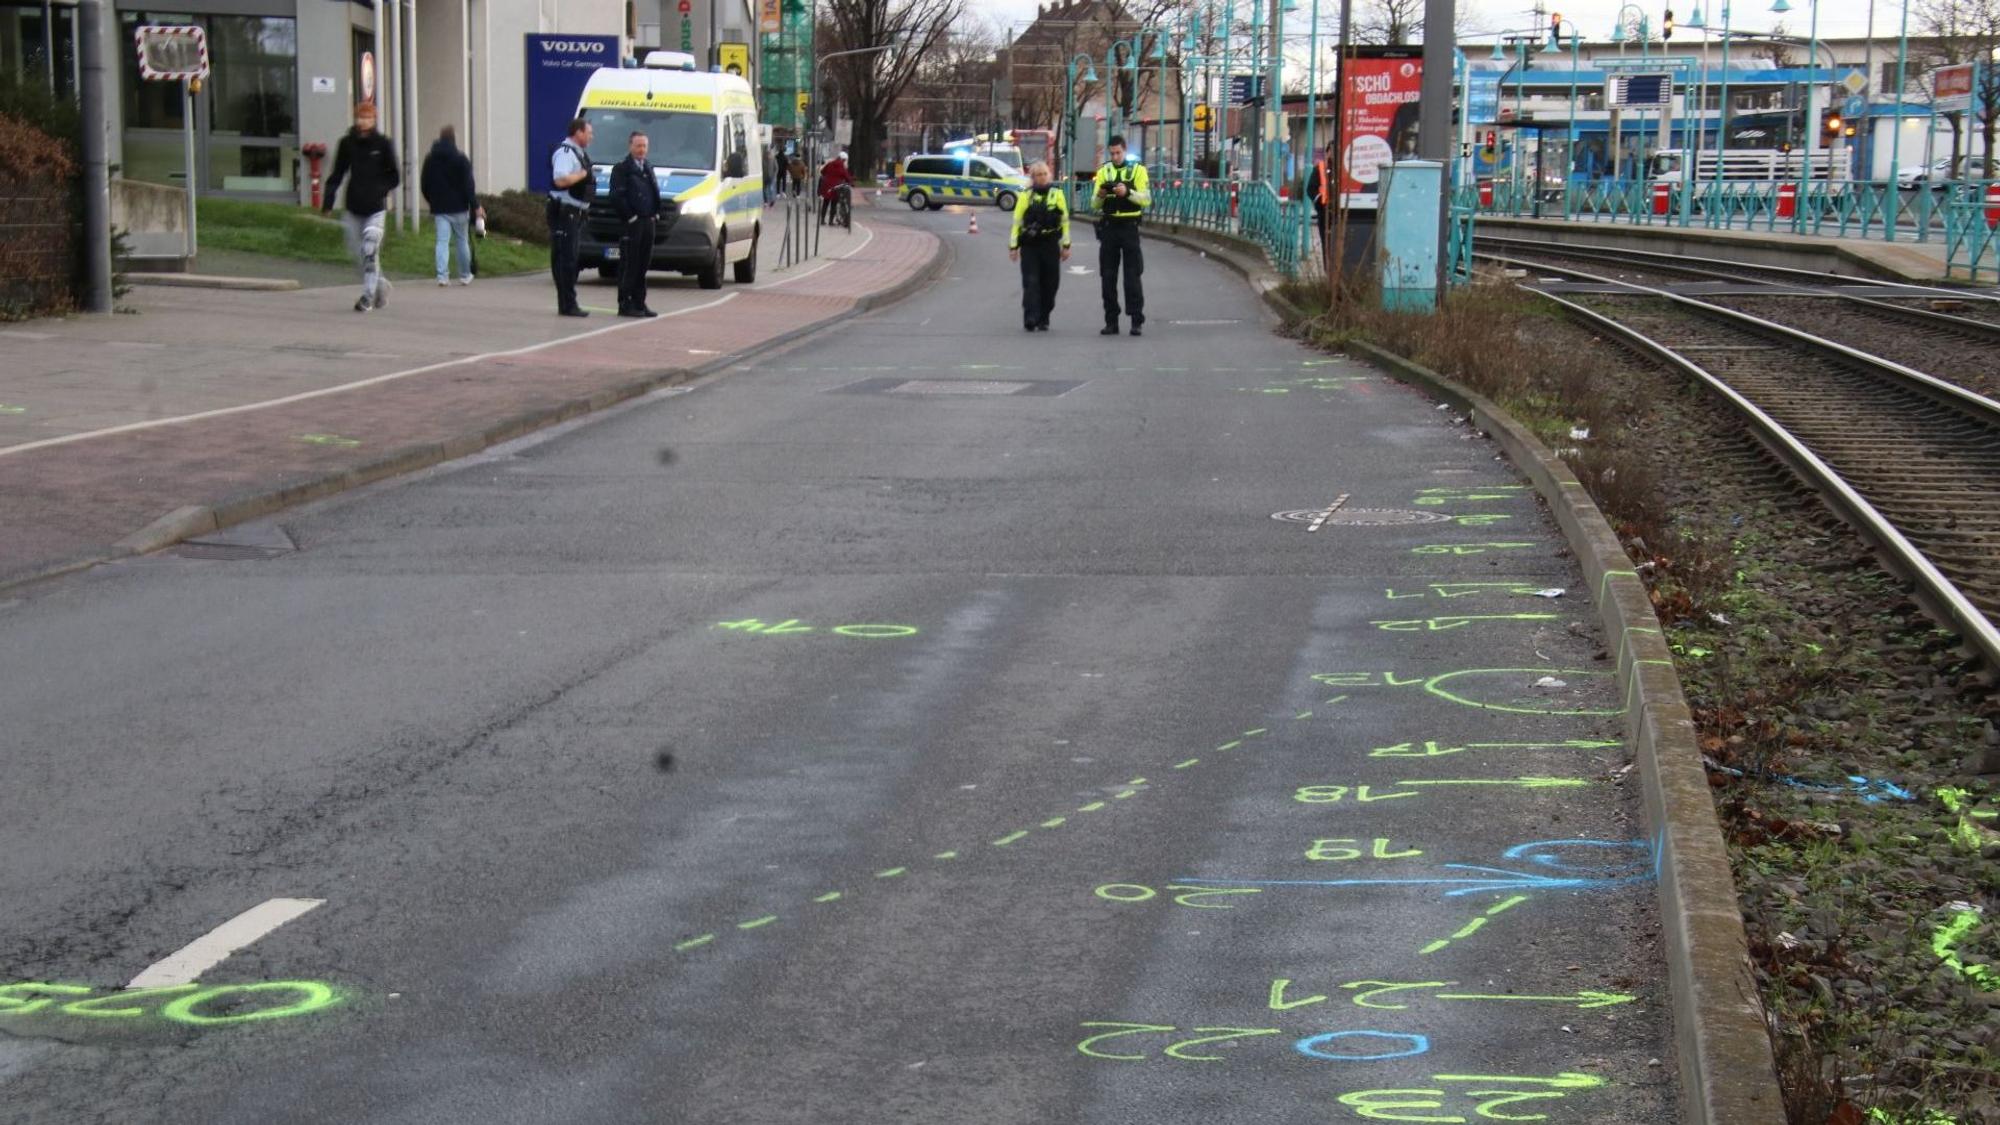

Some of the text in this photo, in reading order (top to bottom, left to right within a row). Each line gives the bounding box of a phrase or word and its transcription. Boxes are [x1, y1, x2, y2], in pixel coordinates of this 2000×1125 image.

[540, 41, 605, 53] VOLVO
[542, 59, 561, 67] Volvo
[600, 100, 698, 111] UNFALLAUFNAHME
[1310, 671, 1424, 686] 13
[1294, 785, 1419, 803] 18
[1304, 838, 1423, 861] 19
[1094, 883, 1262, 909] 20
[1269, 979, 1446, 1010] 21
[1077, 1021, 1281, 1060] 22
[1338, 1088, 1565, 1122] 23
